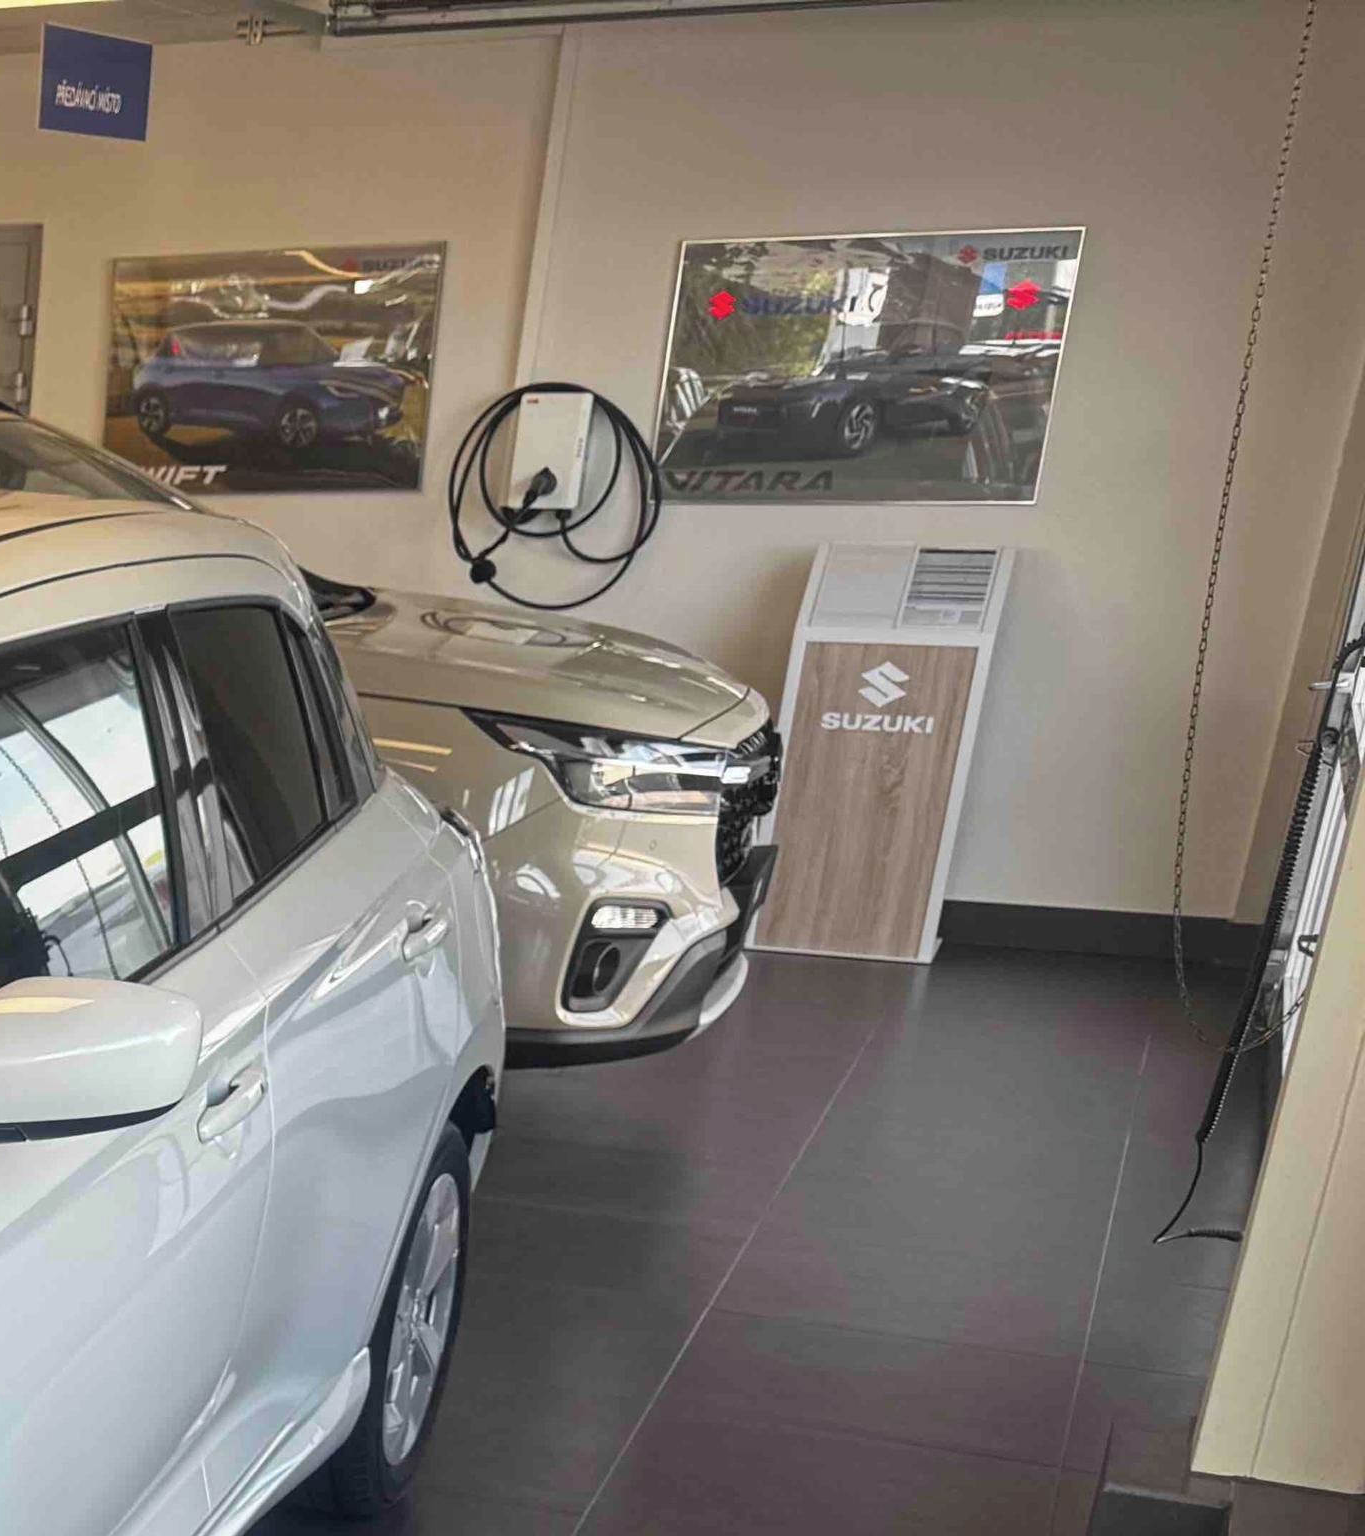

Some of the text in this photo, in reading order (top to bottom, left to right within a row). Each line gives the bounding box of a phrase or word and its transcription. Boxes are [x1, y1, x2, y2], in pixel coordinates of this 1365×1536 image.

[982, 245, 1070, 260] SUZUKI
[140, 464, 228, 486] WIFT
[664, 469, 834, 492] VITARA
[820, 711, 934, 734] SUZUKI
